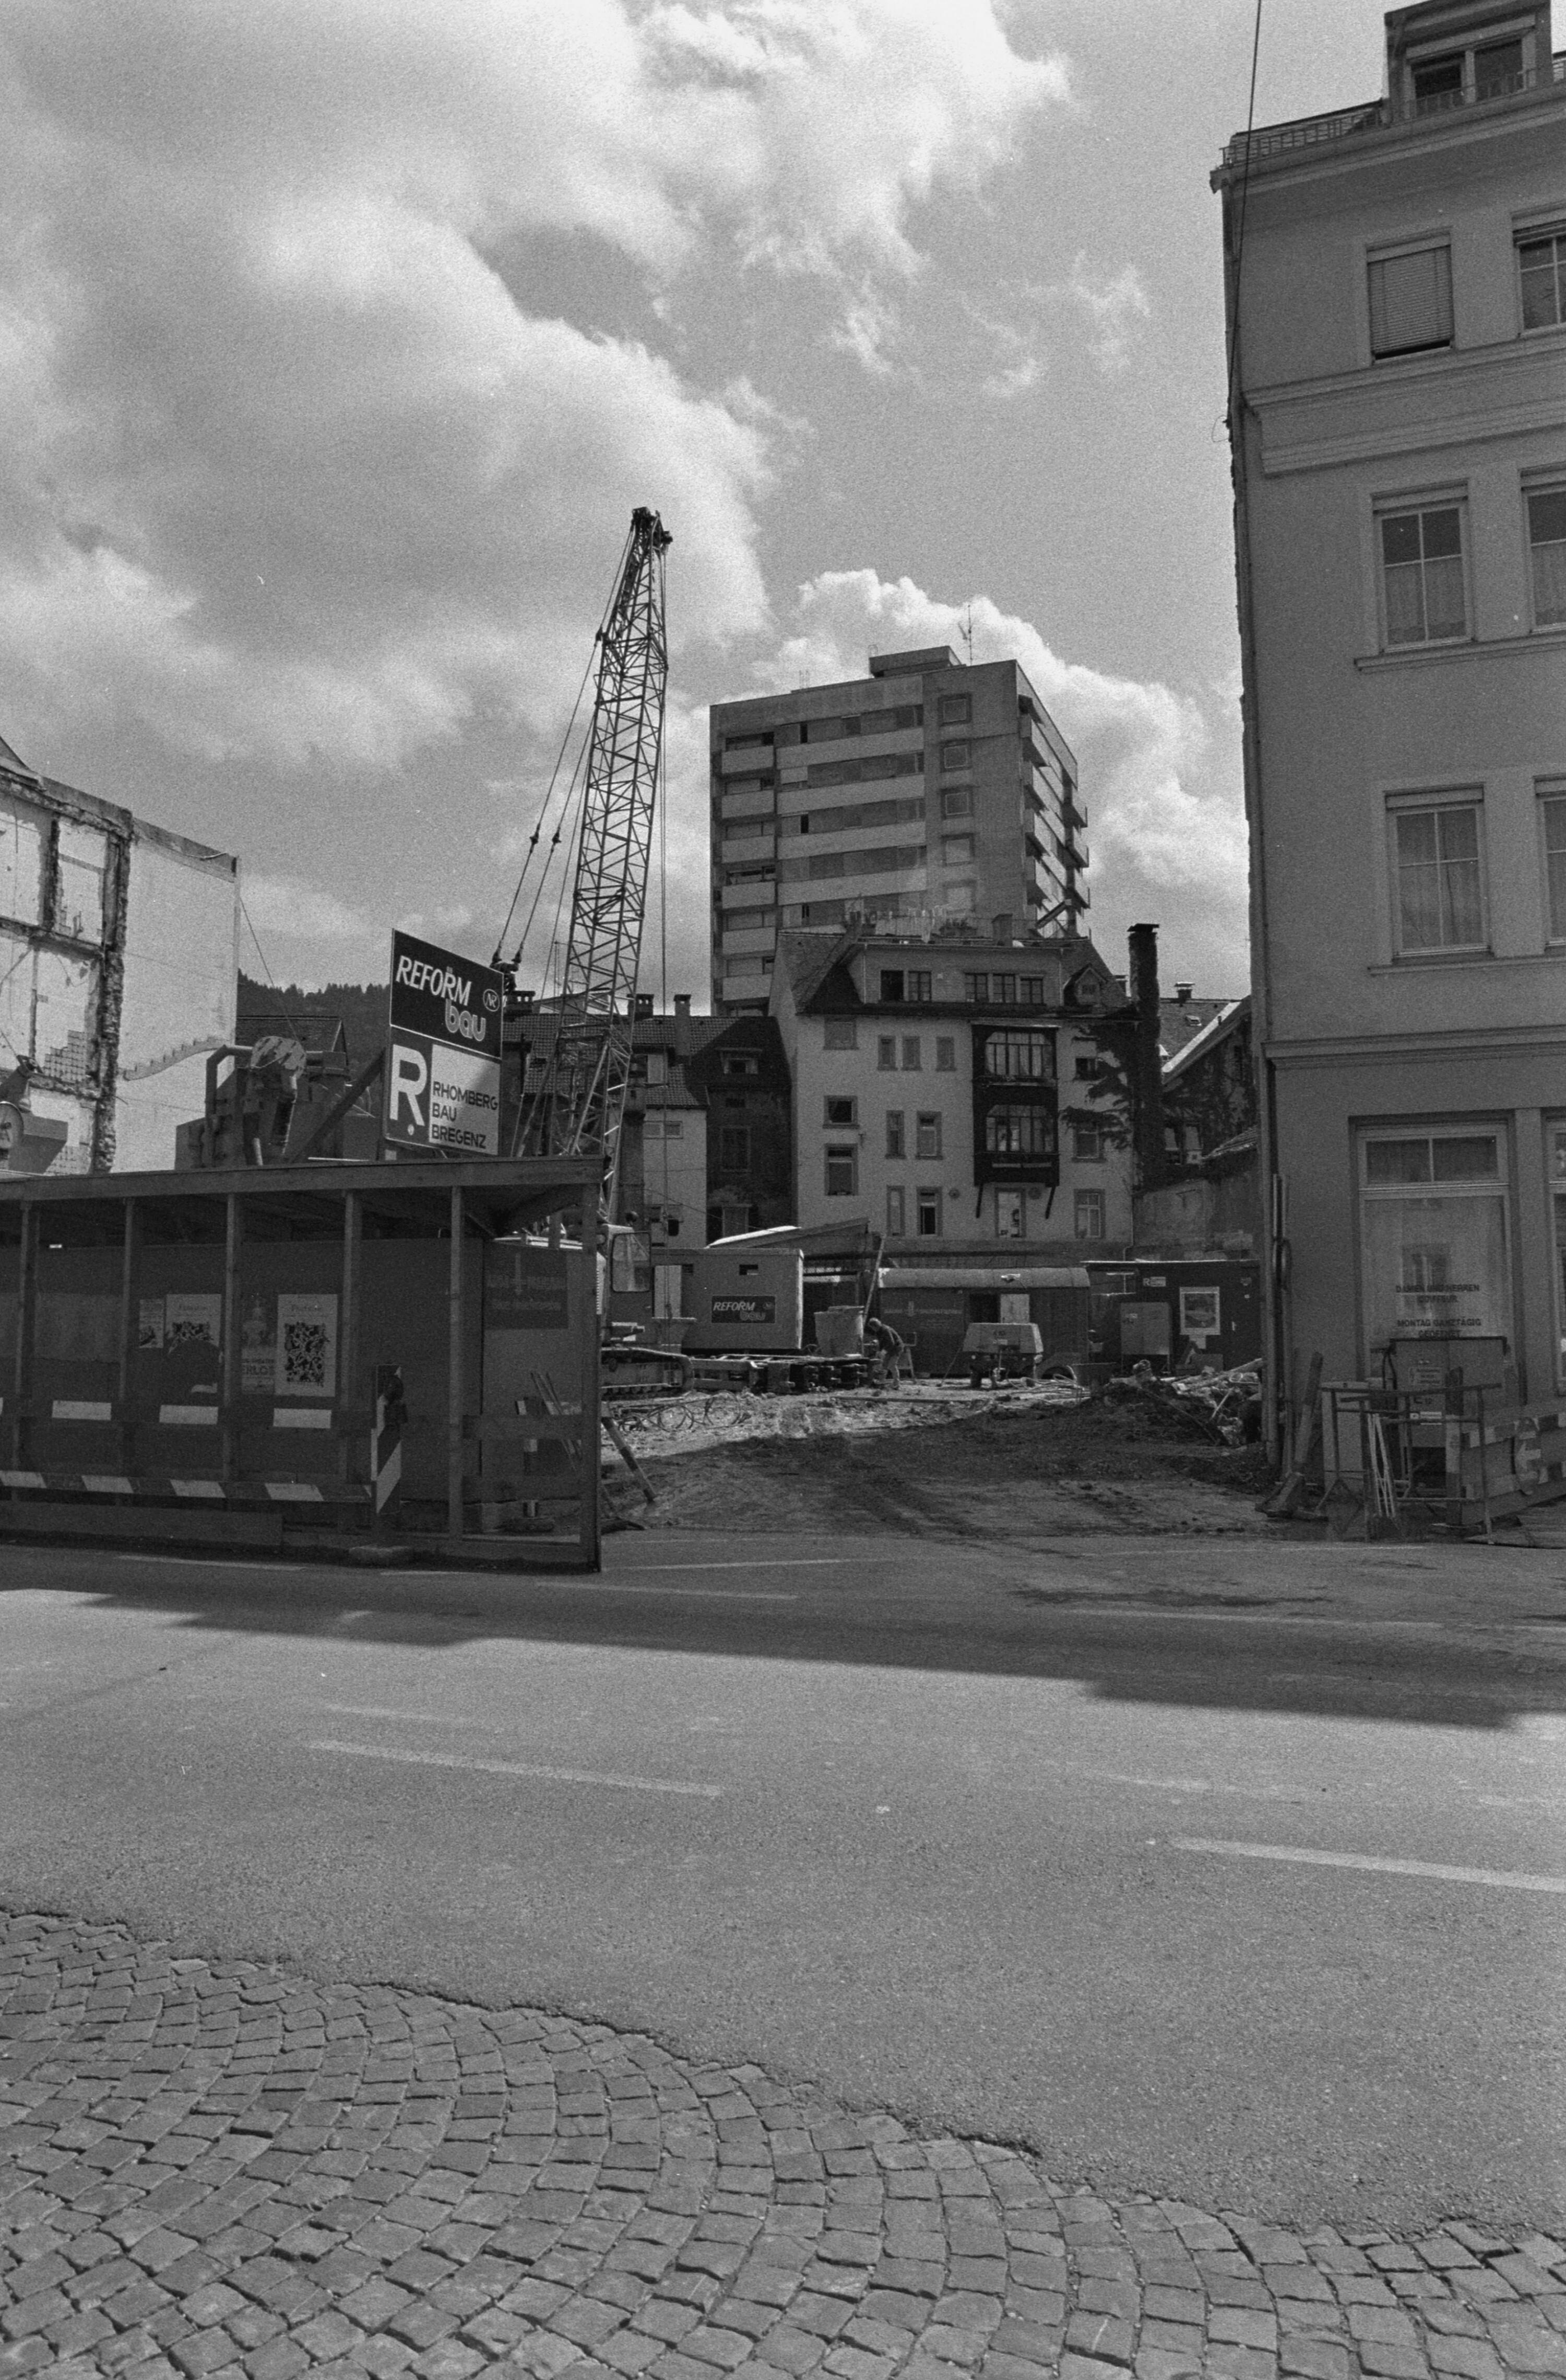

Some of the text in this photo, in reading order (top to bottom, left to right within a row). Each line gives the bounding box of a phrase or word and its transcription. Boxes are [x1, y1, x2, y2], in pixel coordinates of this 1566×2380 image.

[396, 955, 472, 1006] REFORM
[445, 981, 486, 1041] bau
[389, 1044, 427, 1126] R
[433, 1081, 498, 1110] RHOMBERG
[432, 1102, 457, 1122] BAU
[431, 1124, 486, 1149] BREGENZ
[713, 1301, 755, 1311] REFORM
